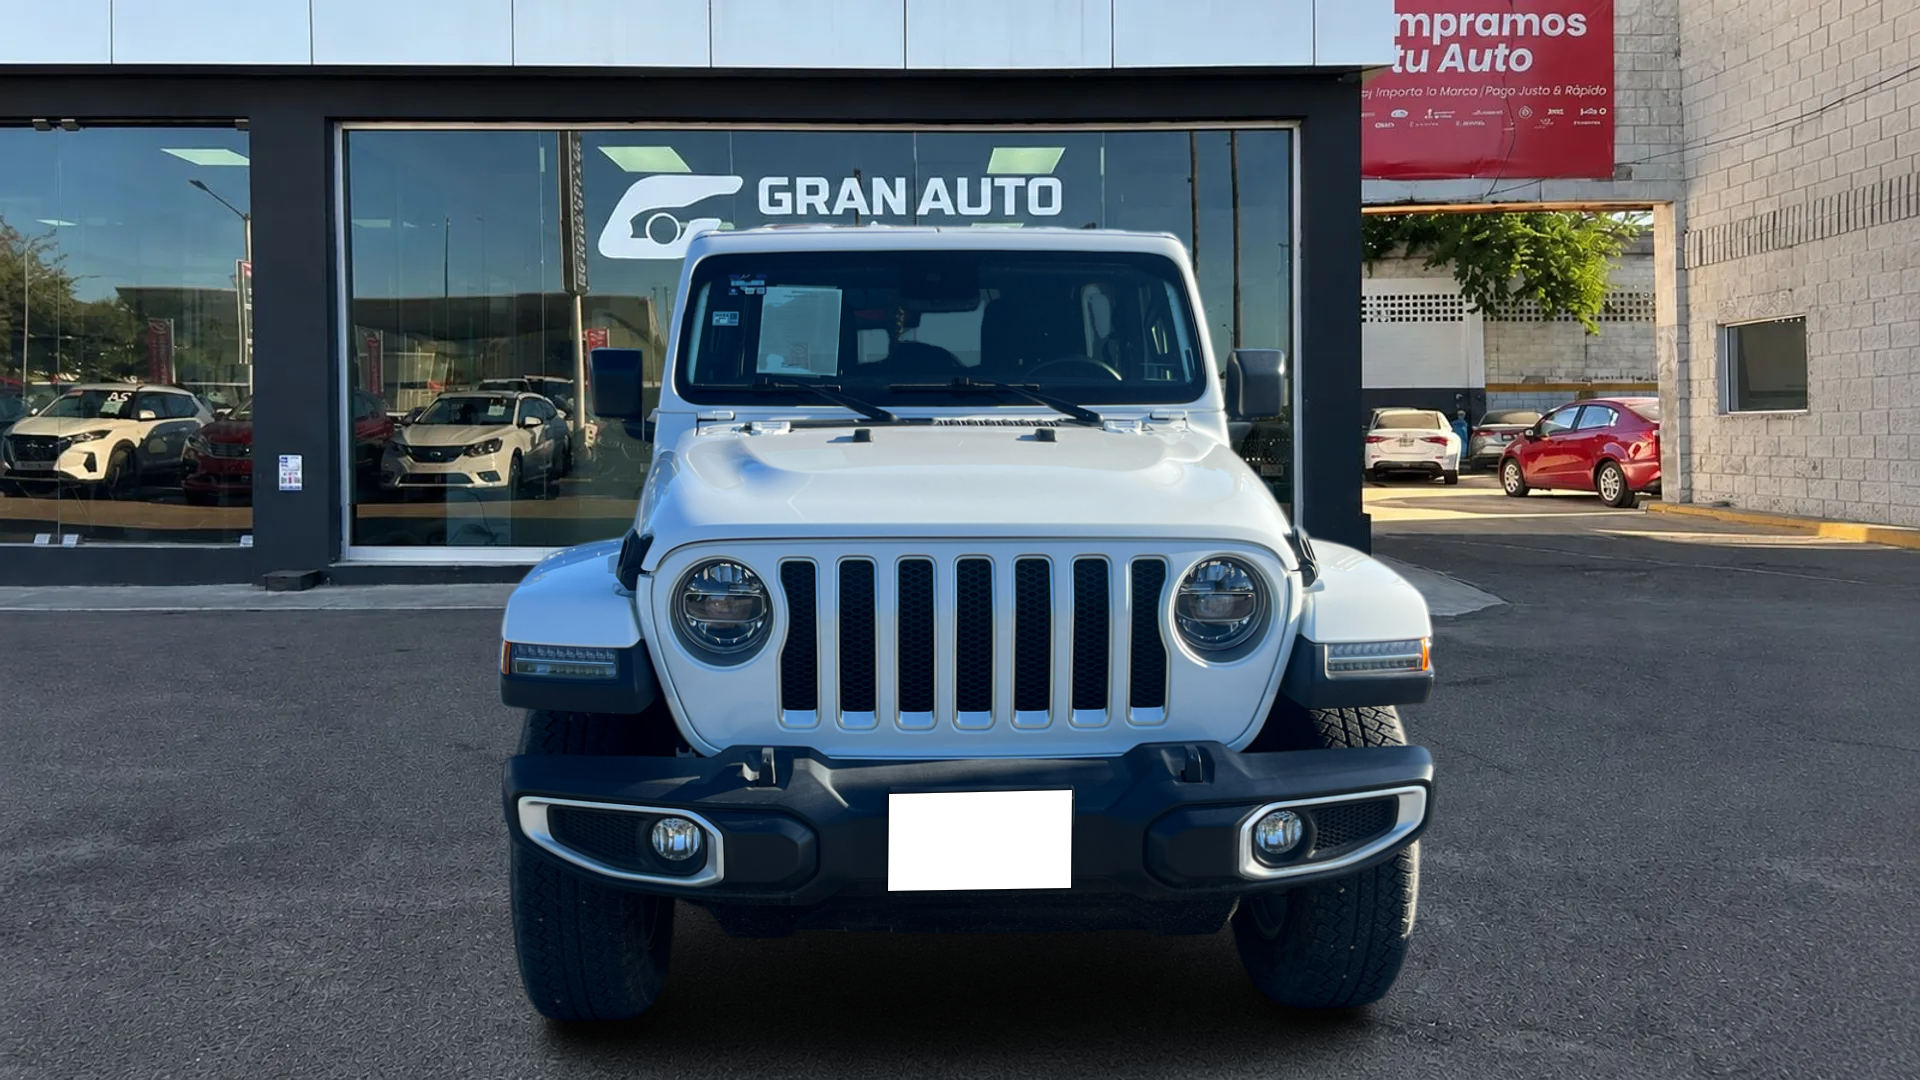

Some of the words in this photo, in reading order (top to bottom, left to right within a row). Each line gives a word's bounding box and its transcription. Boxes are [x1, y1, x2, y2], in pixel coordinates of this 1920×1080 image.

[1393, 44, 1430, 73] tu
[1437, 42, 1534, 73] Auto
[1375, 87, 1424, 99] Importa
[1426, 87, 1437, 97] la
[1439, 86, 1478, 97] Marca
[1519, 85, 1551, 97] Justo
[1552, 86, 1562, 96] &
[1564, 84, 1607, 98] Rápido
[758, 176, 906, 216] GRAN
[916, 176, 1062, 216] AUTO
